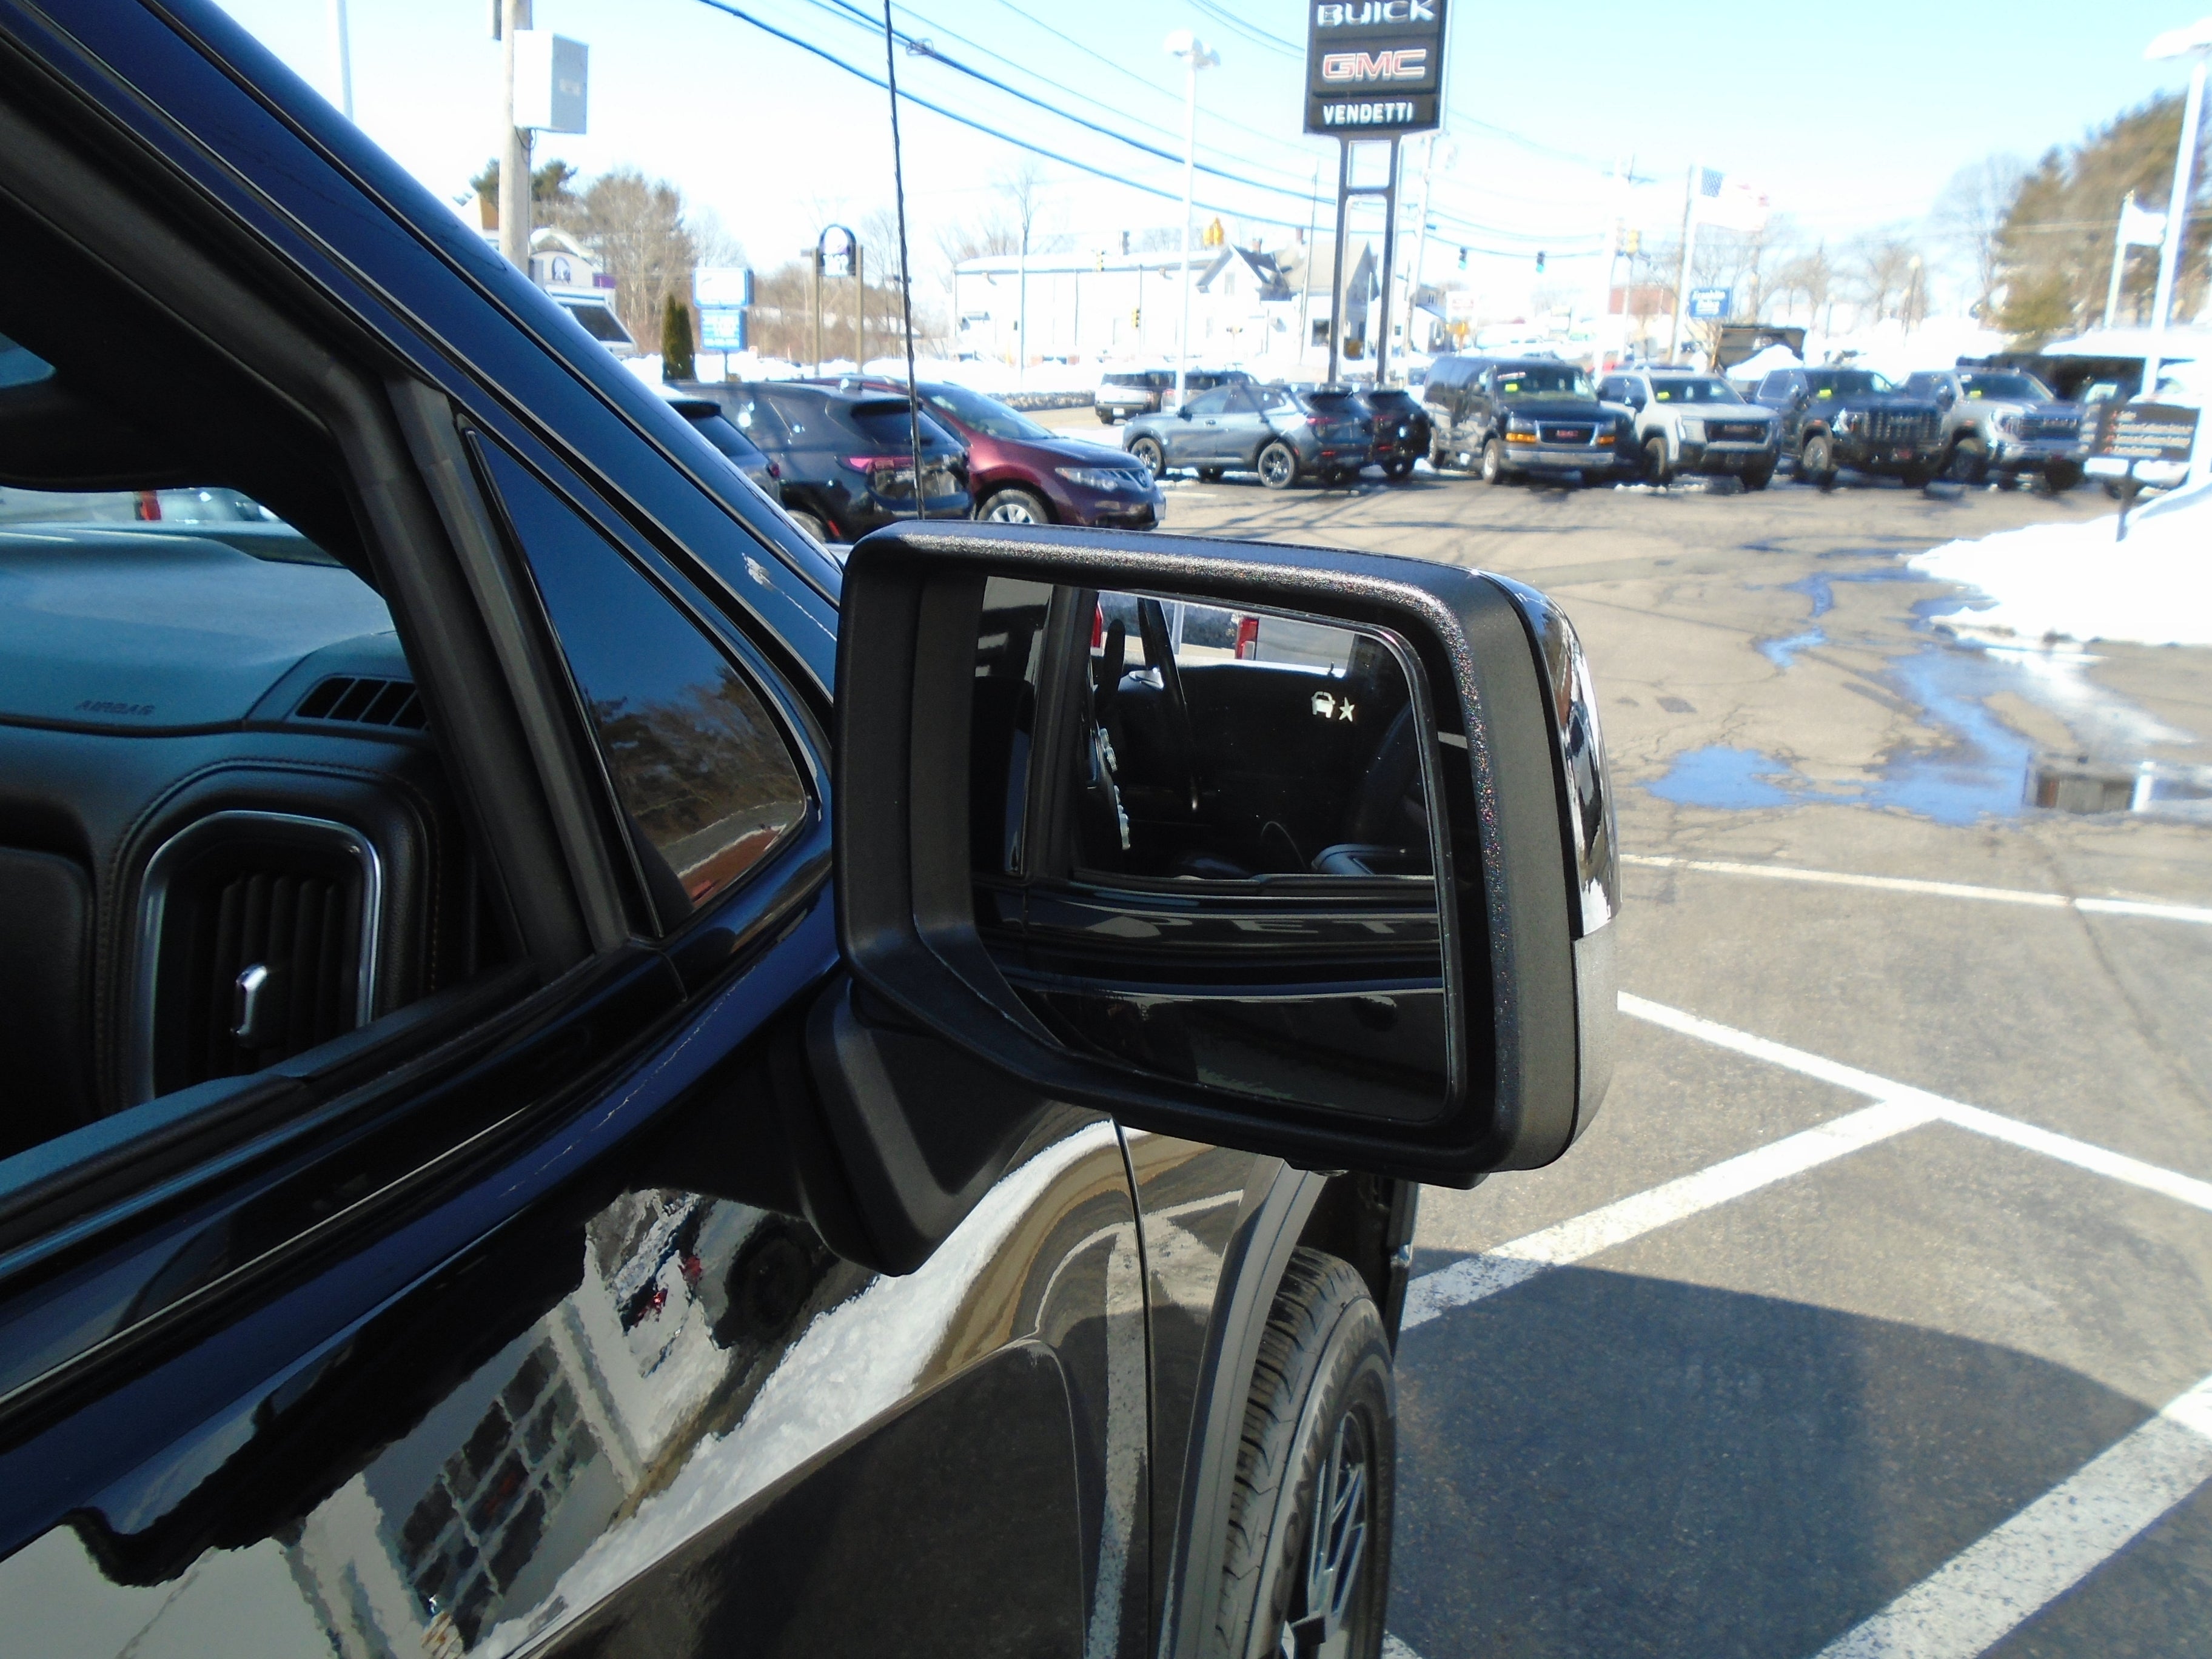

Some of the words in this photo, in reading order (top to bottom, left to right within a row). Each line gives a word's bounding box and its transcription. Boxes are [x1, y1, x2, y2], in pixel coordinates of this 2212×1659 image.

[1317, 0, 1435, 27] BUICK
[1323, 49, 1426, 81] GMC
[1324, 101, 1413, 125] VENDETTI
[74, 700, 156, 716] AIRBAG
